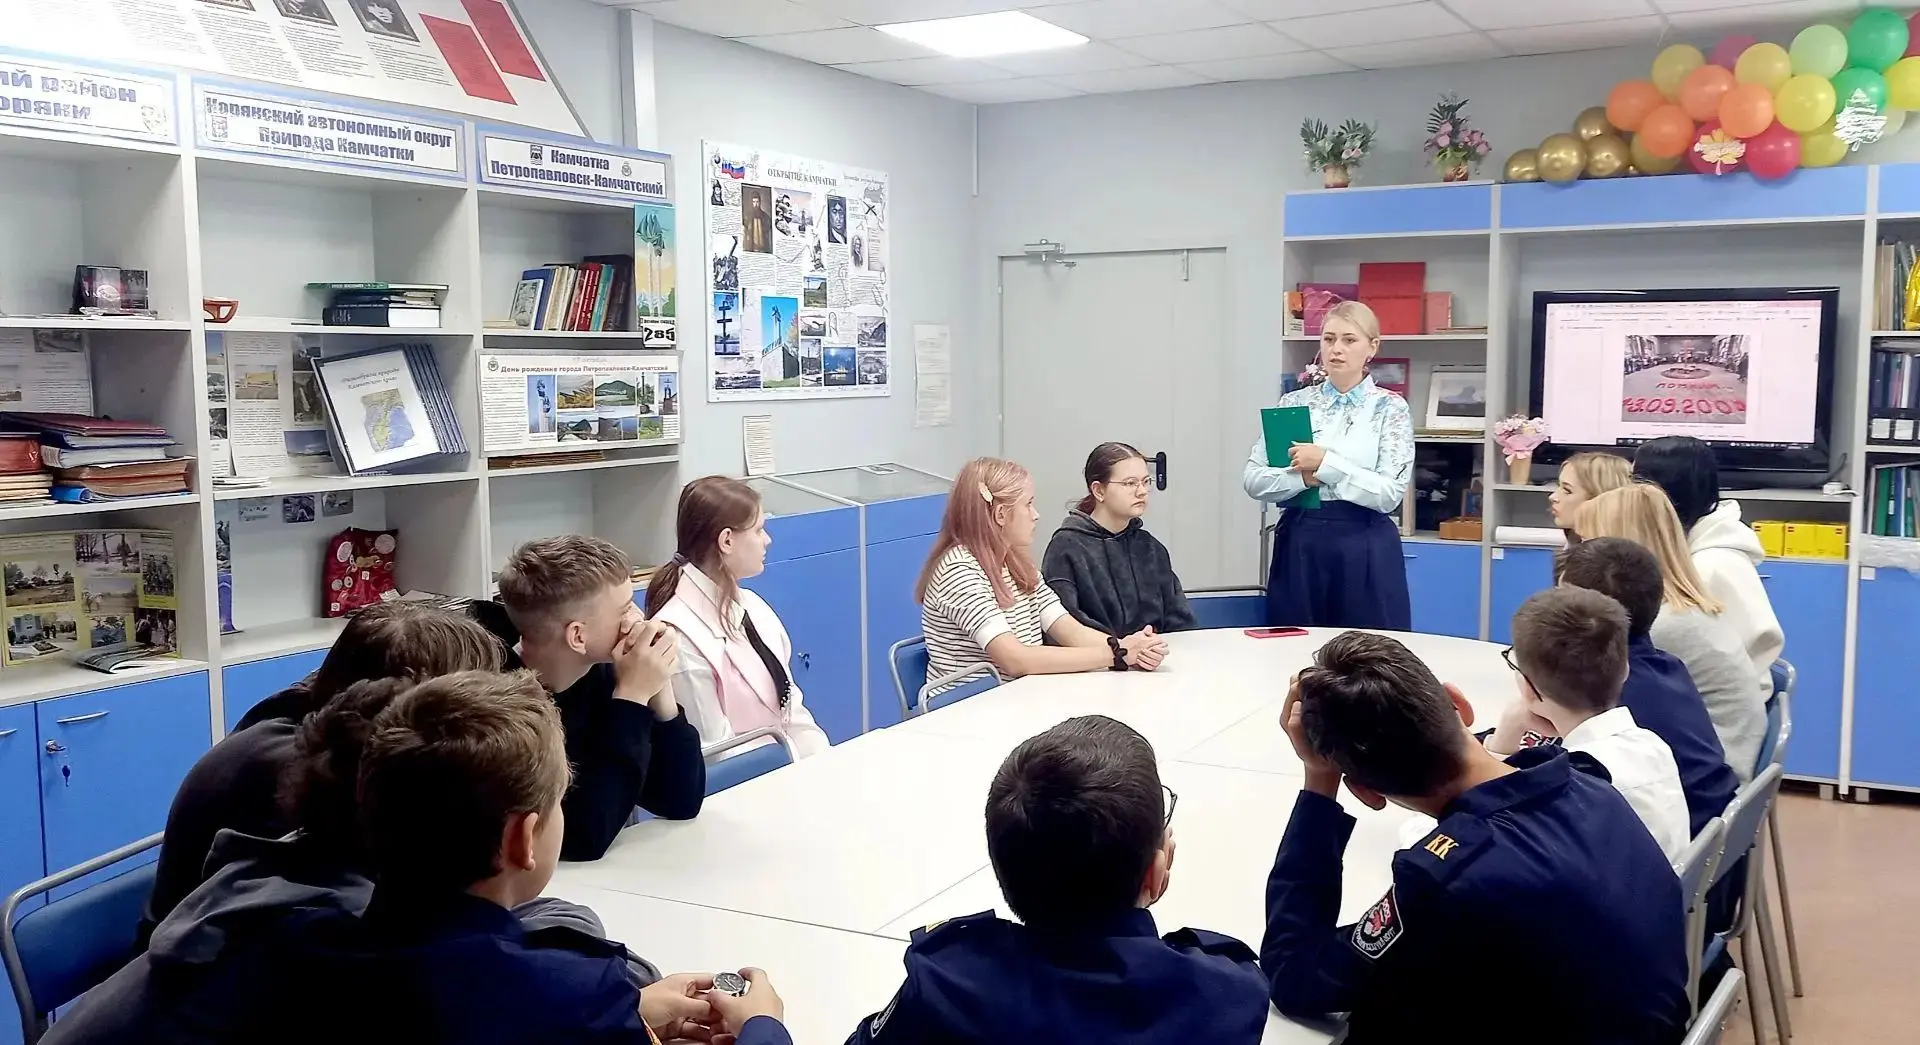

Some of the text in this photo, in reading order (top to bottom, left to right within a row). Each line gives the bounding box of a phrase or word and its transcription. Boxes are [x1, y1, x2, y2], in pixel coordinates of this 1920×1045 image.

[41, 76, 136, 103] район
[206, 97, 453, 148] Корякский автономный округ
[258, 127, 415, 162] Природа Камчатки
[551, 150, 610, 170] Камчатка
[491, 160, 664, 195] Петропавловск-Камчатский
[767, 168, 803, 182] ОТКРЫТИЕ
[803, 174, 837, 187] КАМЧАТКИ
[644, 327, 675, 342] 285
